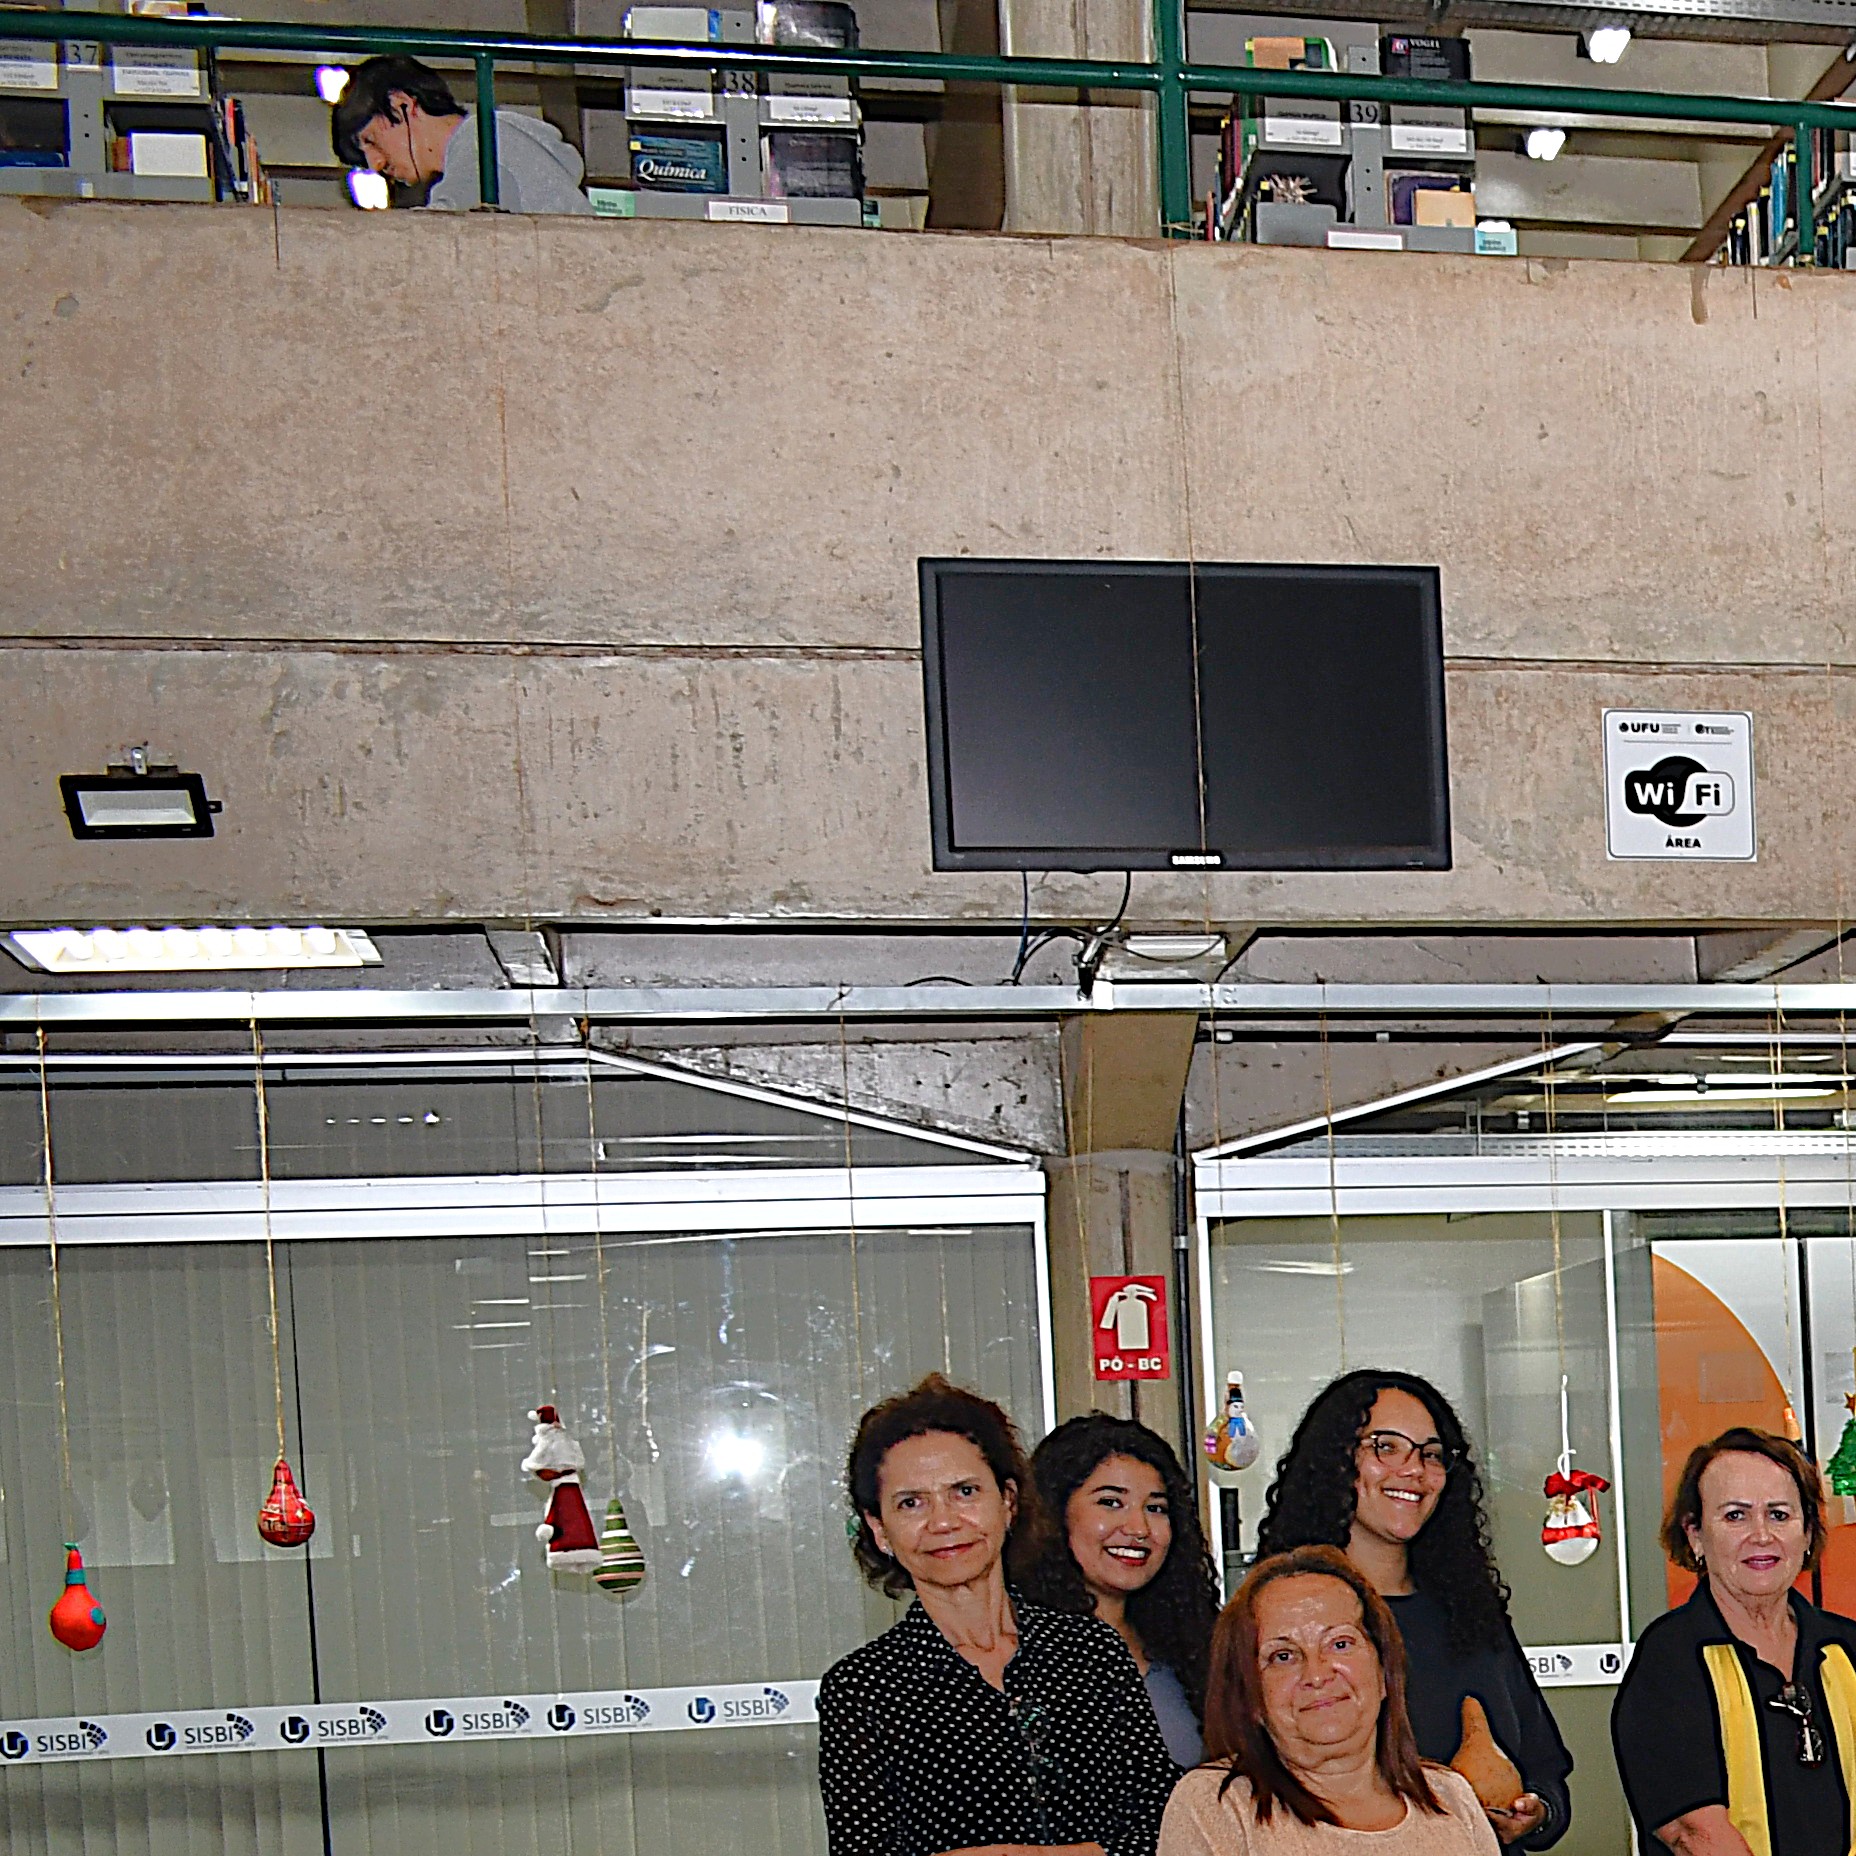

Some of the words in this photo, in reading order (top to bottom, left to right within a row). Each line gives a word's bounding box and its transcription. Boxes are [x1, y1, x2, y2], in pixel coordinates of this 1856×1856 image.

[69, 44, 97, 64] 37
[725, 71, 755, 93] 38
[1352, 103, 1378, 123] 39
[1631, 723, 1660, 733] UFU
[1665, 834, 1701, 848] ÁREA
[1138, 1357, 1162, 1371] BC
[583, 1707, 630, 1725] SISBI
[723, 1699, 770, 1717] SISBI
[318, 1720, 366, 1737] SISBI
[462, 1713, 510, 1730] SISBI
[37, 1734, 87, 1752] SISBI
[185, 1726, 233, 1744] SISBI
